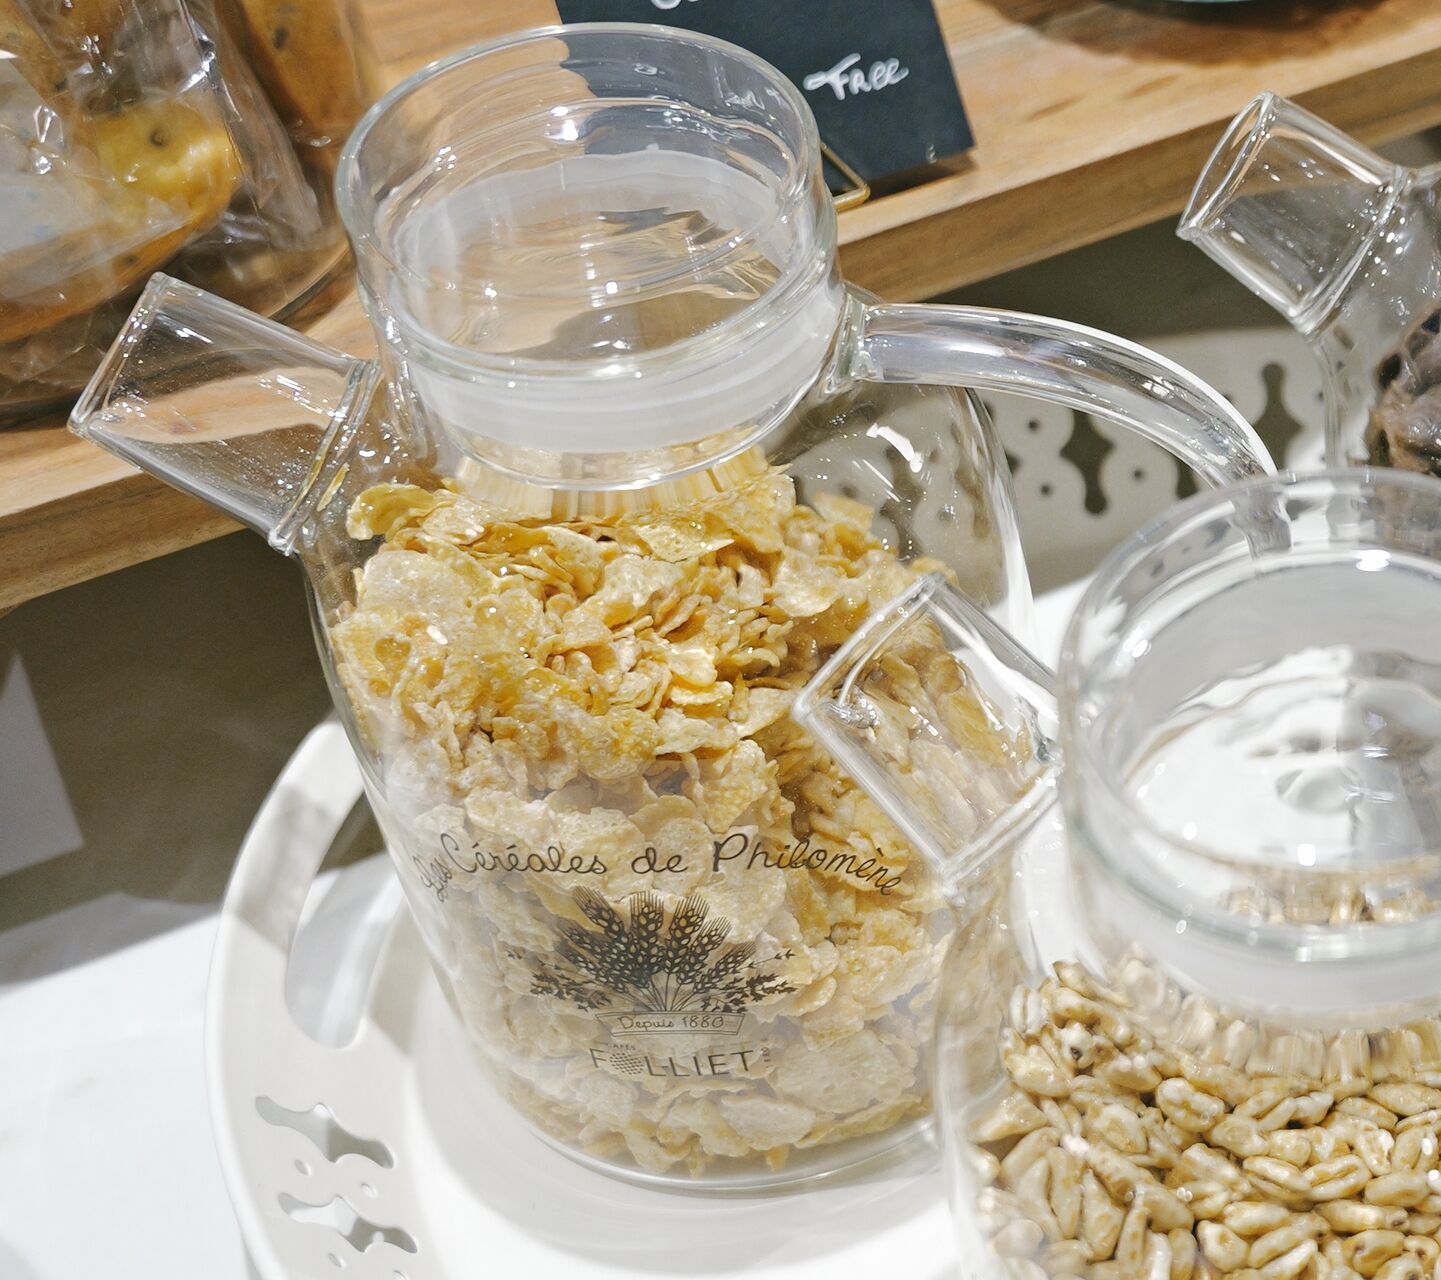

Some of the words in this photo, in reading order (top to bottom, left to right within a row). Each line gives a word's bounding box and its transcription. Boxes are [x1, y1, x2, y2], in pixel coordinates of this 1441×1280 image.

[439, 832, 608, 875] Céréales
[631, 846, 689, 875] de
[711, 832, 902, 897] Philomène
[616, 1014, 675, 1032] Depuis
